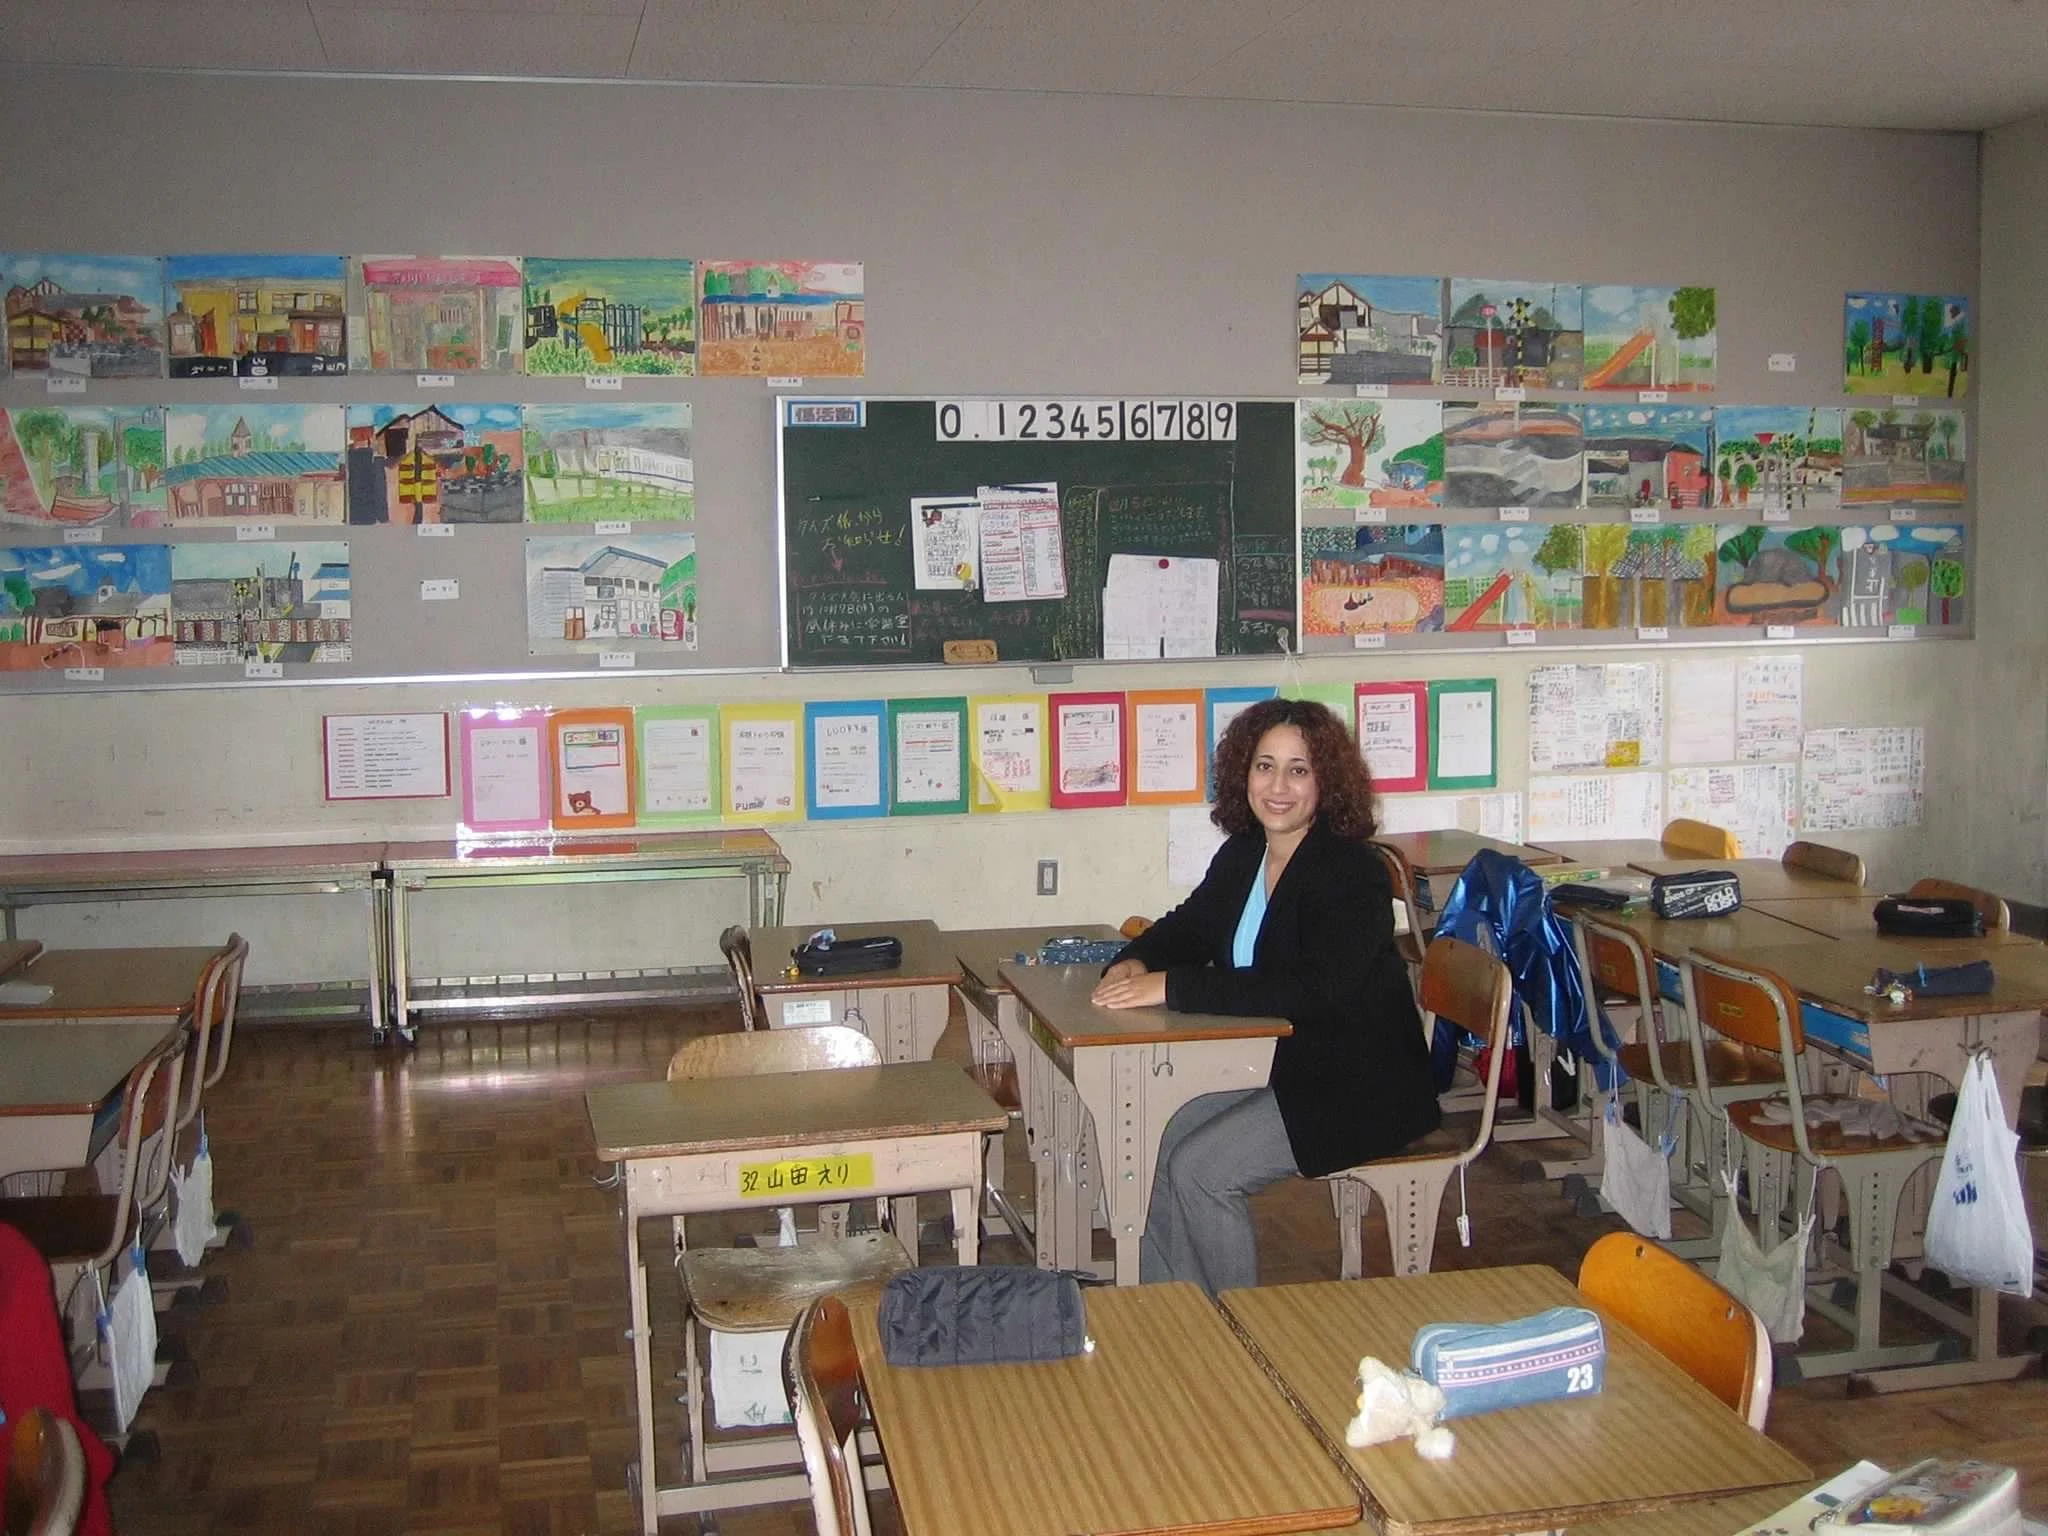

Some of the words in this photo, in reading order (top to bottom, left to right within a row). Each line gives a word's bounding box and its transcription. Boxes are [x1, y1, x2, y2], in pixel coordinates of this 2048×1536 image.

[1704, 886, 1734, 905] GOLD
[767, 1166, 808, 1189] 山田
[818, 1163, 849, 1187] えり
[1567, 1363, 1594, 1394] 23
